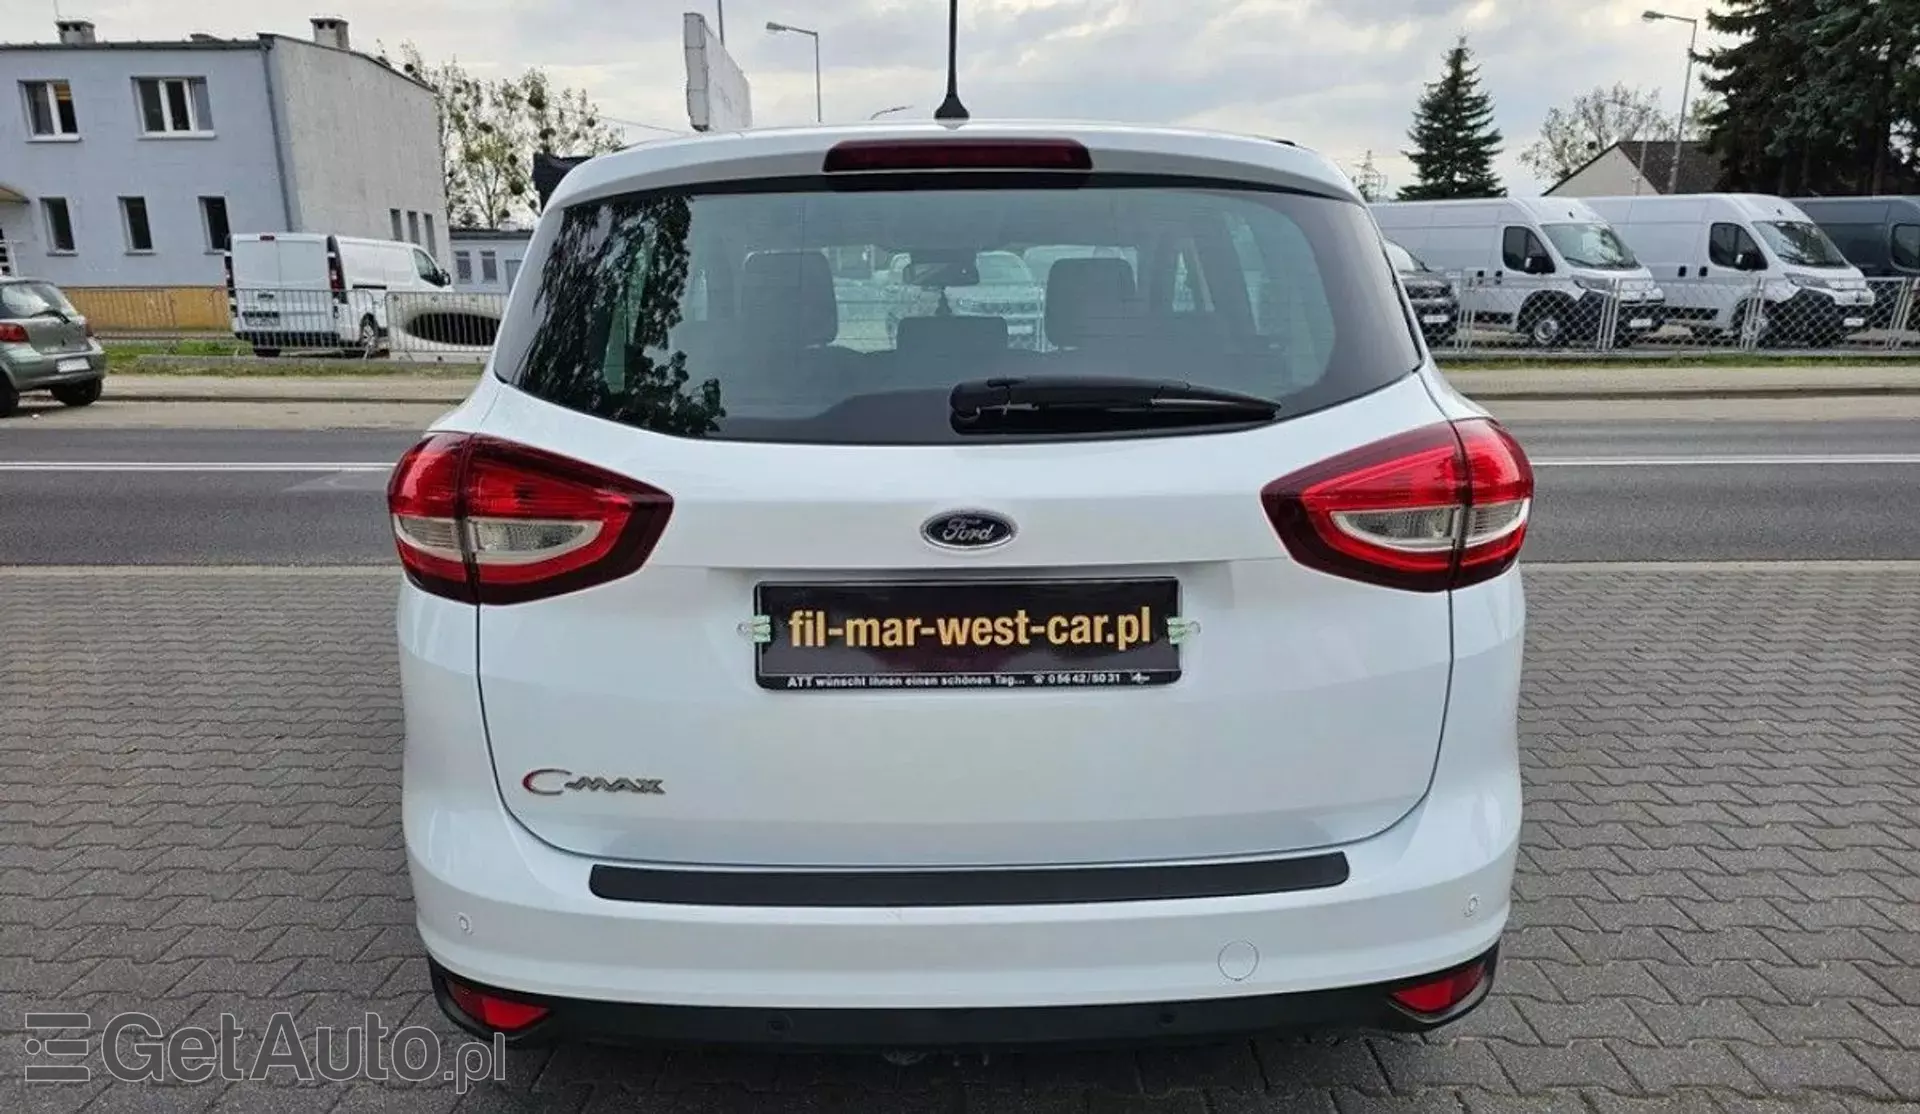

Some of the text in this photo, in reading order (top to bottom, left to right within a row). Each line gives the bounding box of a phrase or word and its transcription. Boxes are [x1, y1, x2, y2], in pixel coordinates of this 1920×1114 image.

[942, 517, 996, 541] Ford
[788, 606, 1151, 650] fil-mar-west-car.pl
[816, 675, 866, 687] wünscht
[905, 675, 938, 686] einen
[941, 675, 991, 686] schönen
[522, 768, 666, 796] C-MAX
